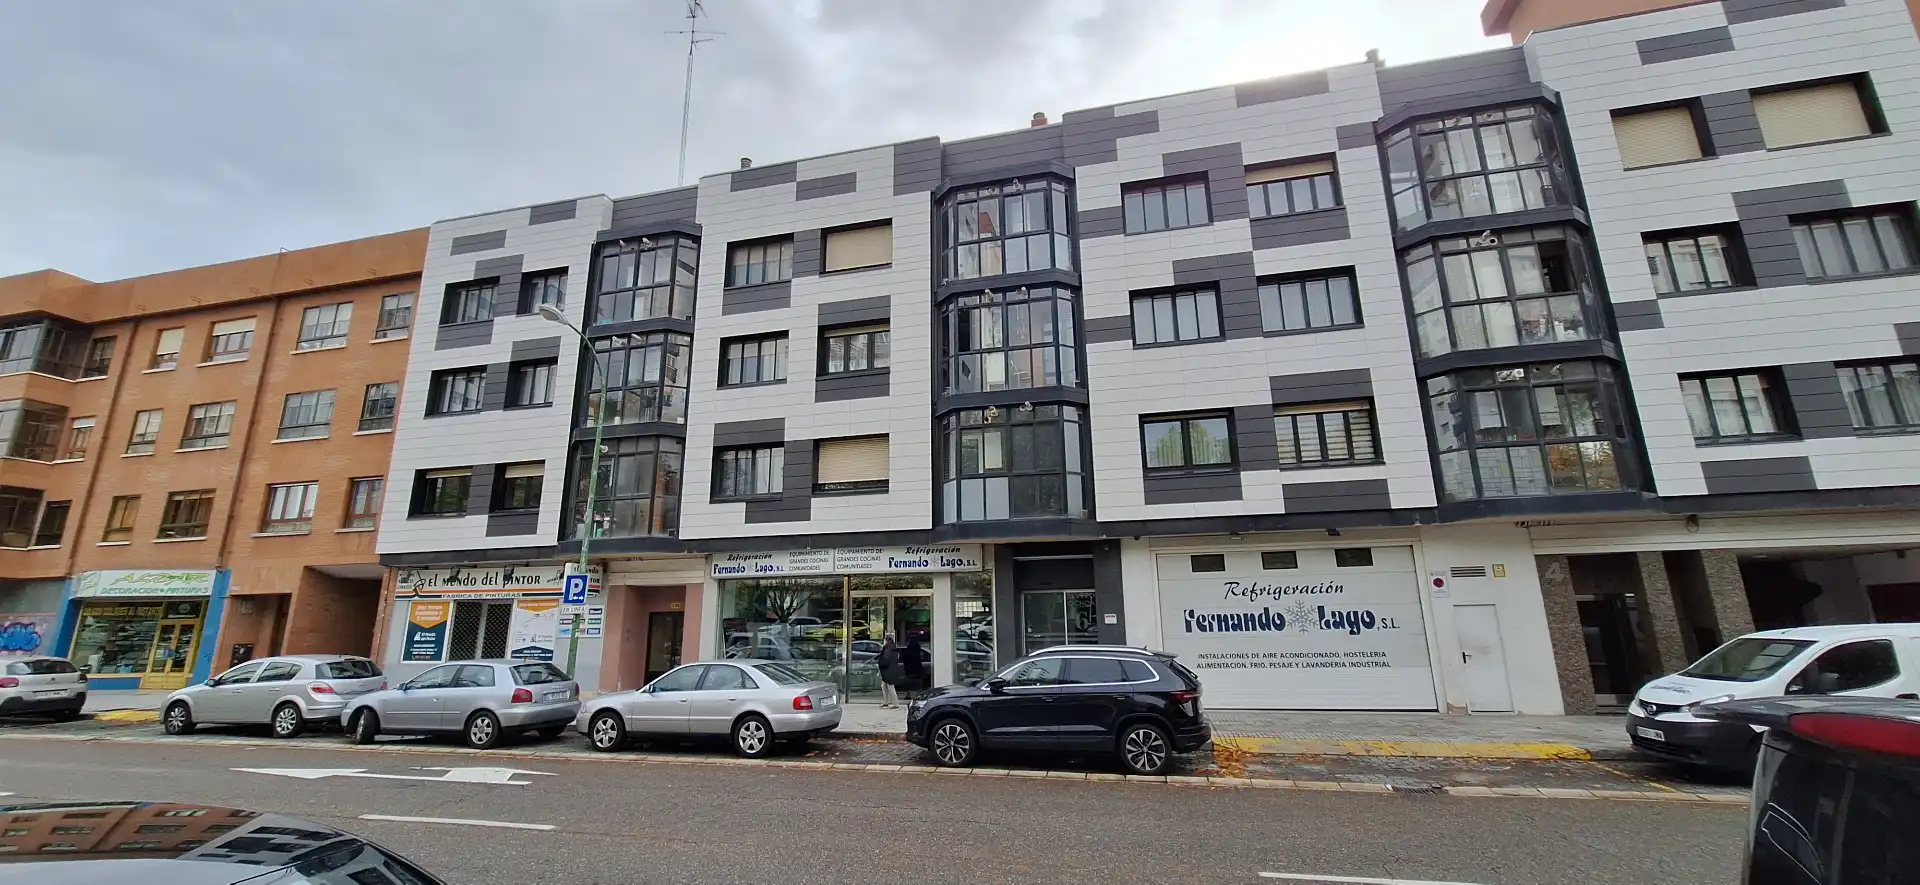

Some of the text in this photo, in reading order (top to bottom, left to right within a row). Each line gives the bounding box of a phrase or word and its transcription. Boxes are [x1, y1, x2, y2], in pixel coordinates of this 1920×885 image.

[727, 553, 772, 561] Refrigeración
[905, 547, 961, 555] Refrigeración
[713, 563, 746, 574] Fernando
[888, 556, 929, 568] Fernando
[569, 578, 583, 600] P
[1223, 581, 1344, 602] Refrigeración
[1075, 612, 1089, 629] 6
[1184, 607, 1286, 633] Fernando
[1381, 617, 1400, 629] S.L.
